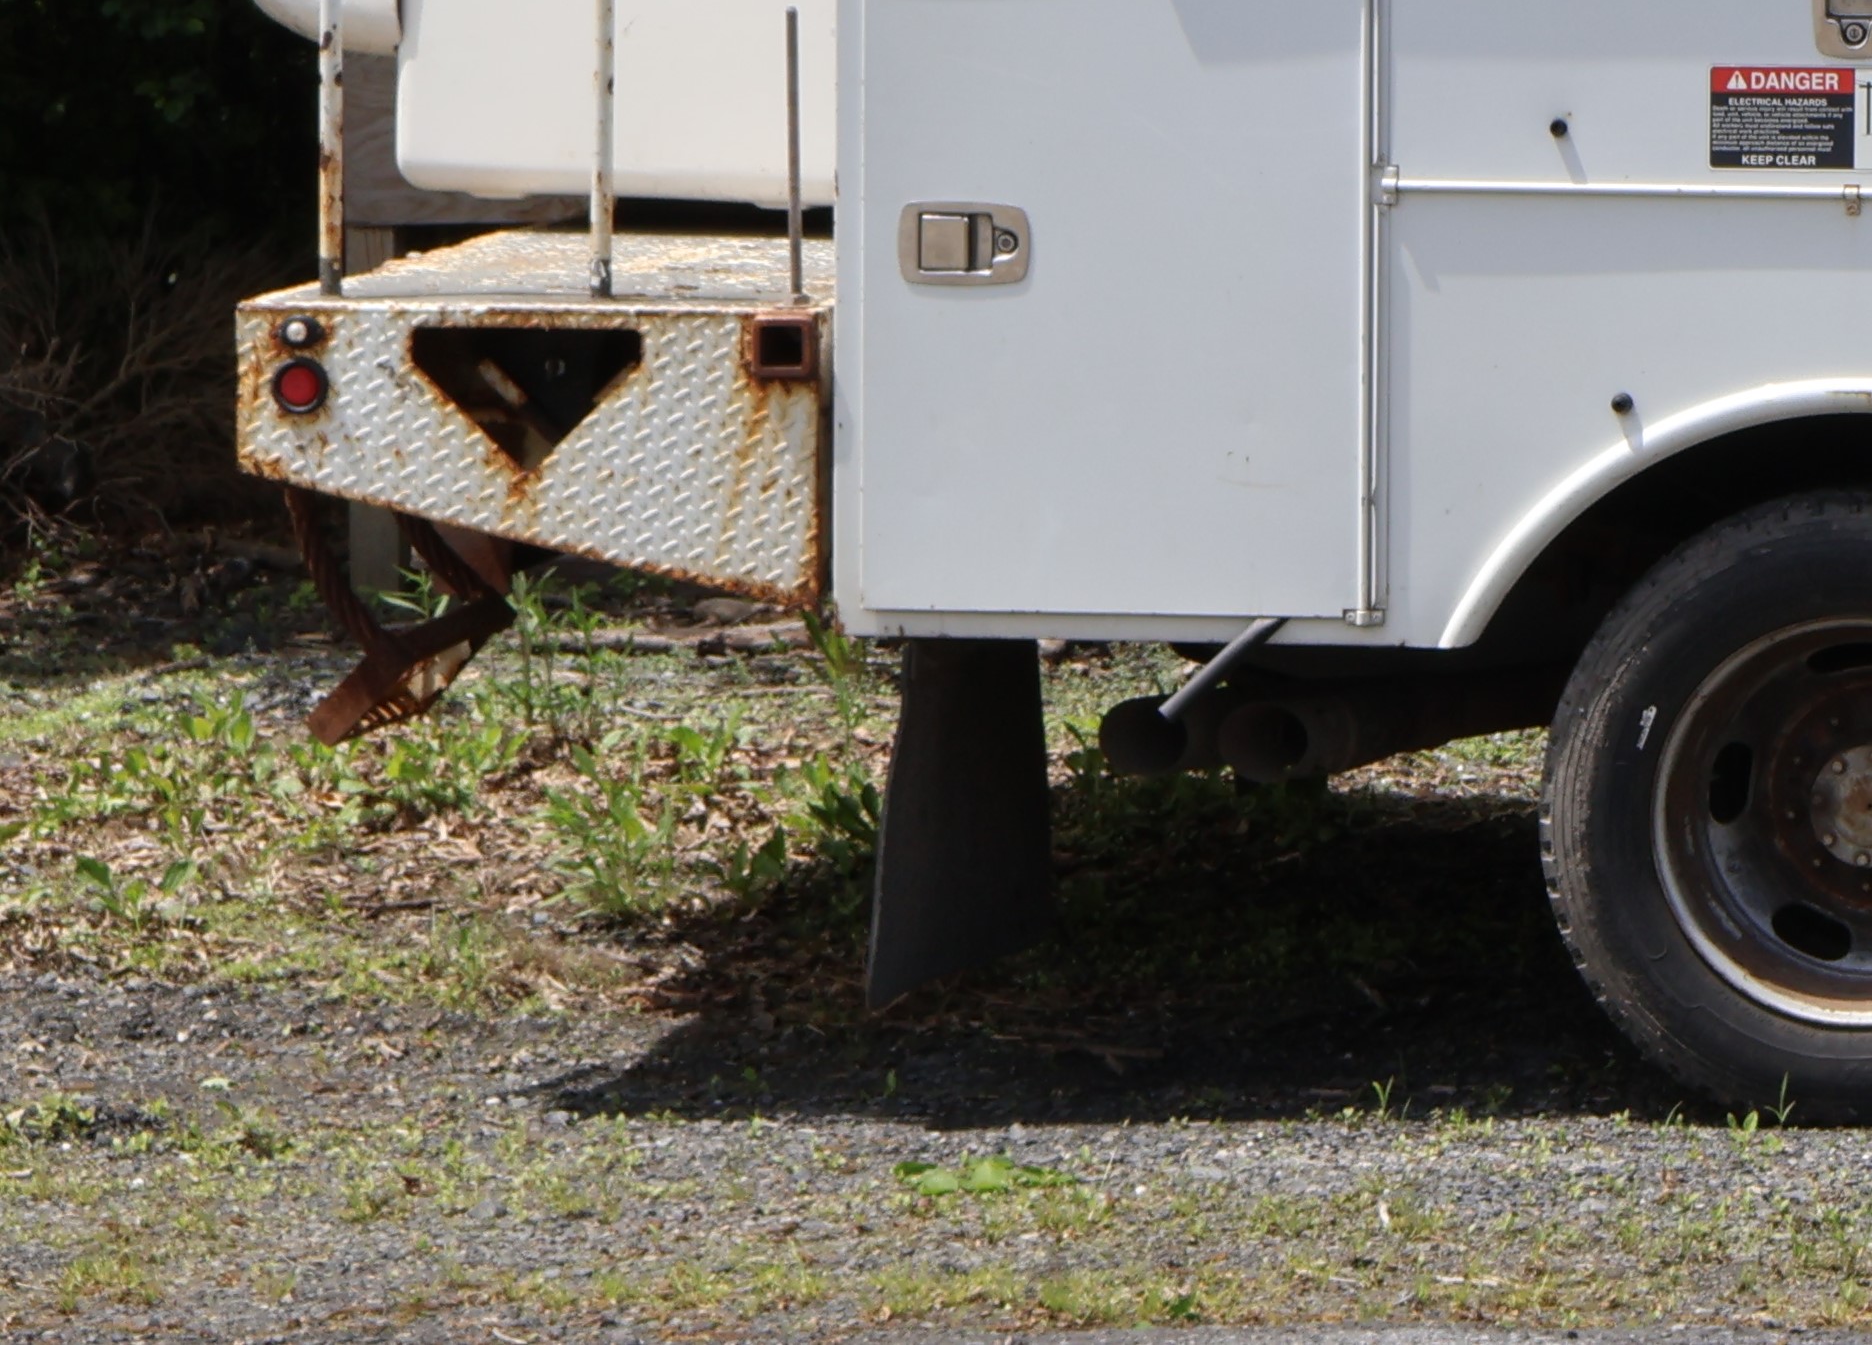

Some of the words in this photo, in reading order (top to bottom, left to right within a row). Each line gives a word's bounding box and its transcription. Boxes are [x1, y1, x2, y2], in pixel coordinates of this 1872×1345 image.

[1751, 72, 1839, 91] DANGER
[1728, 98, 1782, 106] ELECTRICAL
[1785, 98, 1828, 106] HAZARDS
[1741, 155, 1774, 165] KEEP
[1775, 155, 1817, 165] CLEAR
